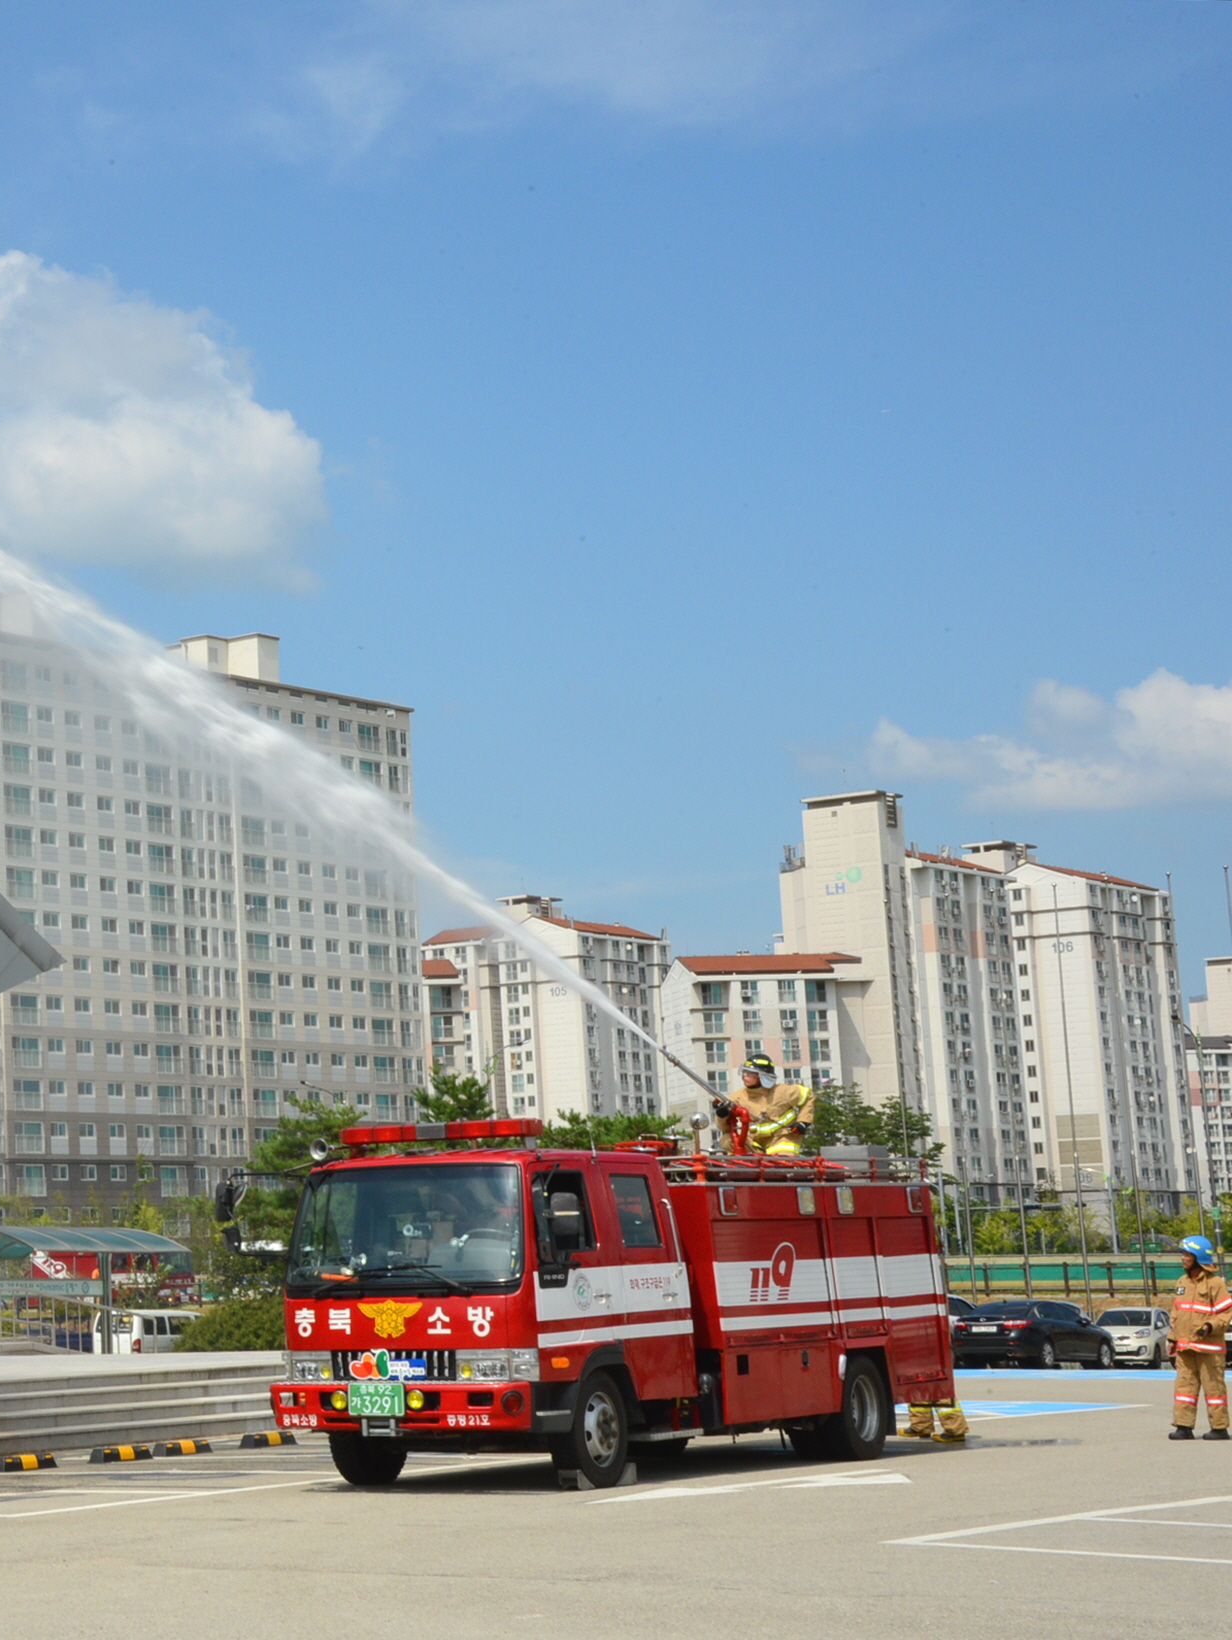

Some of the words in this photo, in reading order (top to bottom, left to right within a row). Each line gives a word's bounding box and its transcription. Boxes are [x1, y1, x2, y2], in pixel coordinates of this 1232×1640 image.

[825, 882, 846, 896] LH
[1052, 941, 1074, 954] 106
[549, 986, 568, 998] 105
[750, 1242, 796, 1290] 119
[378, 1385, 392, 1394] 92
